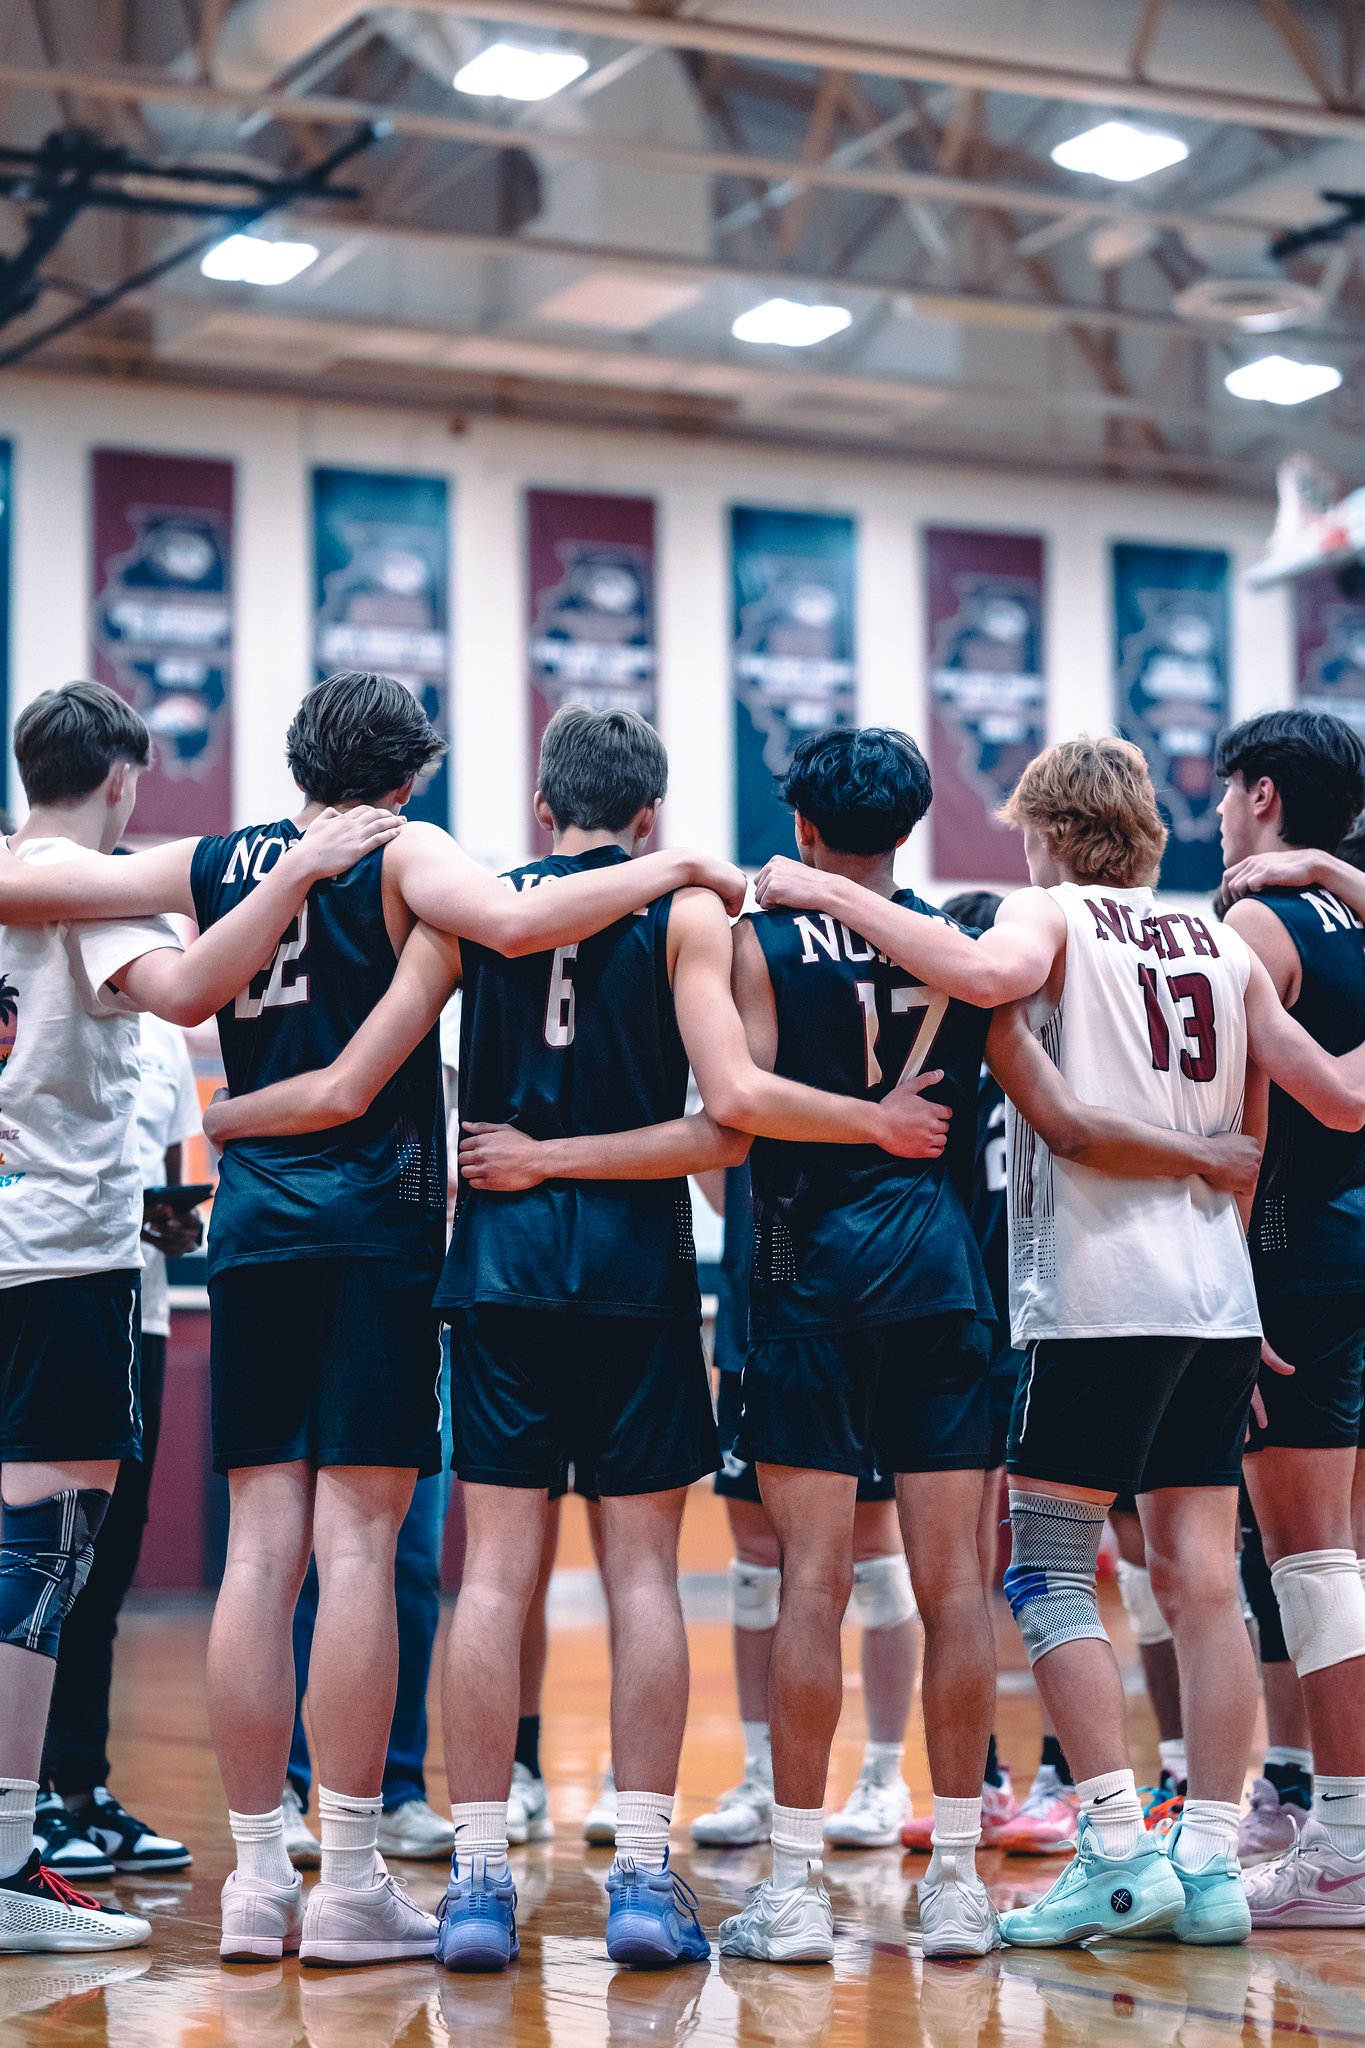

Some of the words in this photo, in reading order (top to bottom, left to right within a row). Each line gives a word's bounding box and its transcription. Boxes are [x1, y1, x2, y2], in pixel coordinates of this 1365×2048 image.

[544, 942, 577, 1049] 6
[856, 980, 950, 1088] 17
[1137, 962, 1217, 1083] 13
